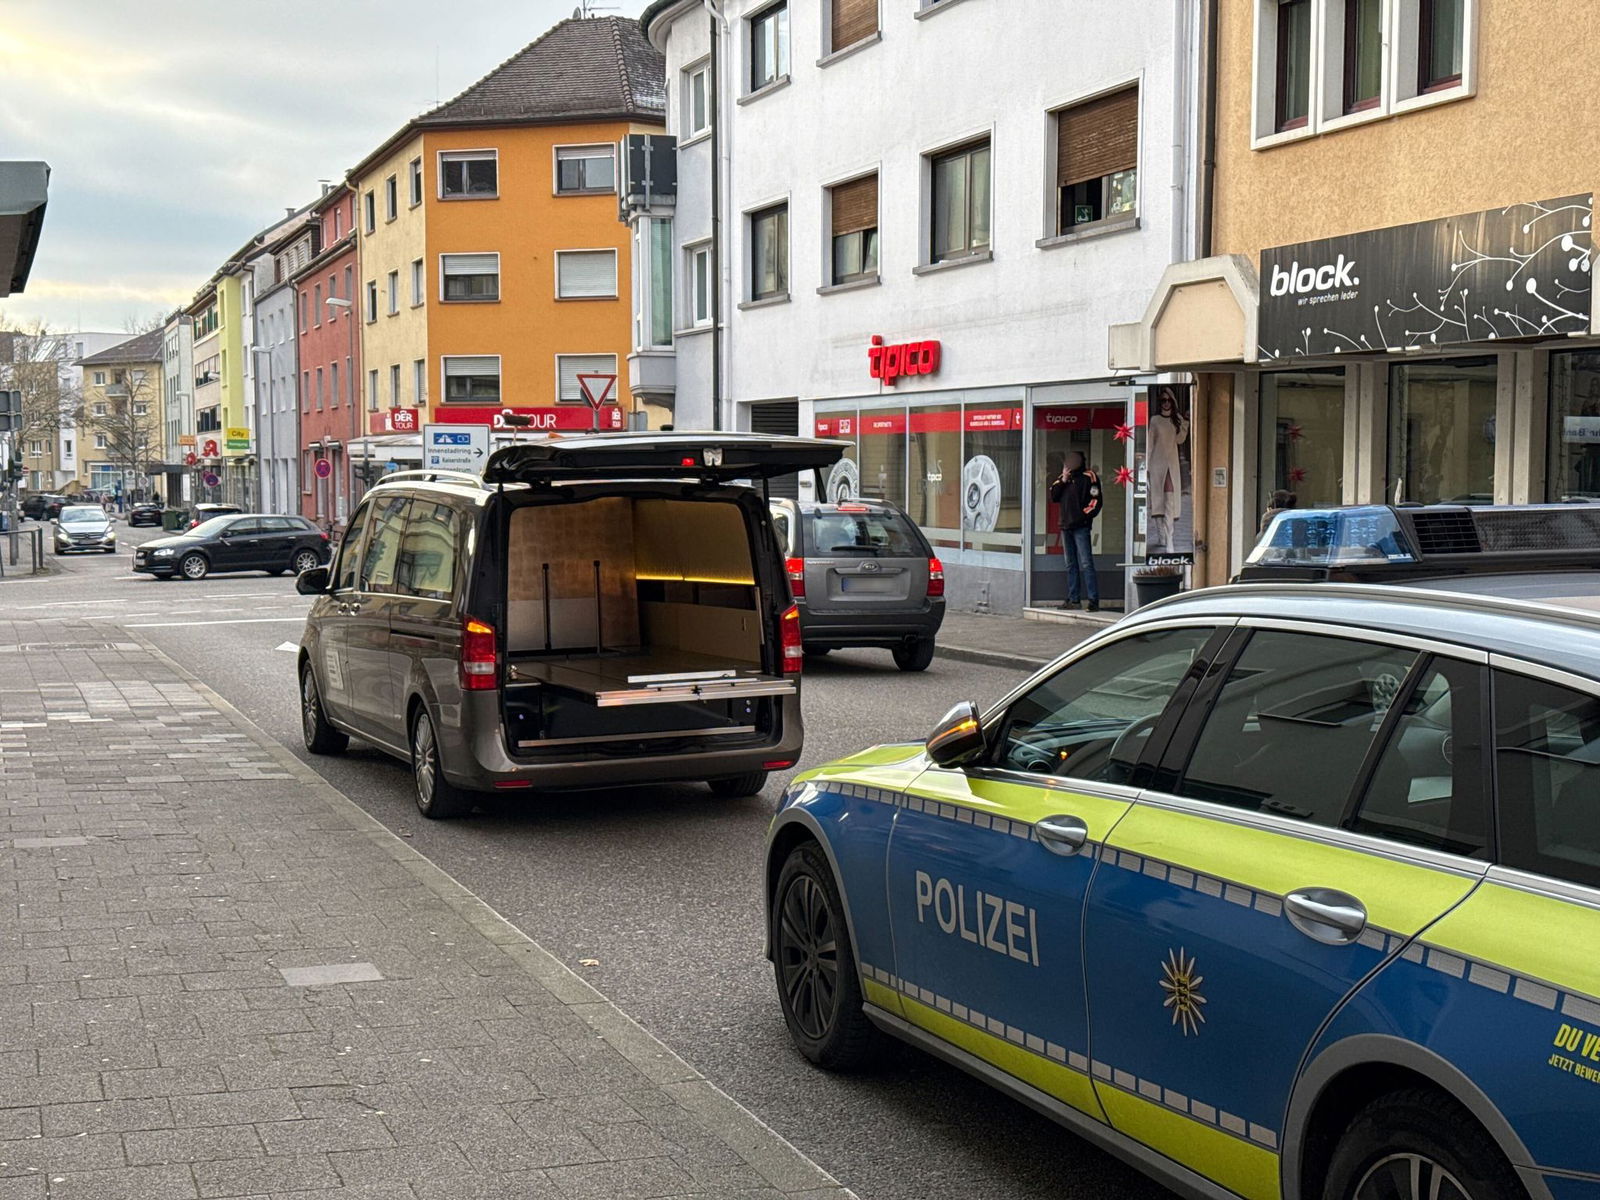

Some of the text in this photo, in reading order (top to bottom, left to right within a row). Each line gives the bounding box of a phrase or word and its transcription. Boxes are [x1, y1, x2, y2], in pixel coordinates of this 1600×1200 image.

[1270, 253, 1360, 297] block.
[1298, 290, 1359, 307] wir sprechen leder
[868, 335, 941, 387] tipico
[394, 411, 413, 422] DER
[493, 411, 557, 429] DOUR
[1045, 412, 1078, 425] tipico
[1148, 555, 1193, 566] block.
[916, 870, 1040, 967] POLIZEI
[1553, 1023, 1584, 1052] DU
[1548, 1053, 1576, 1073] JETZT
